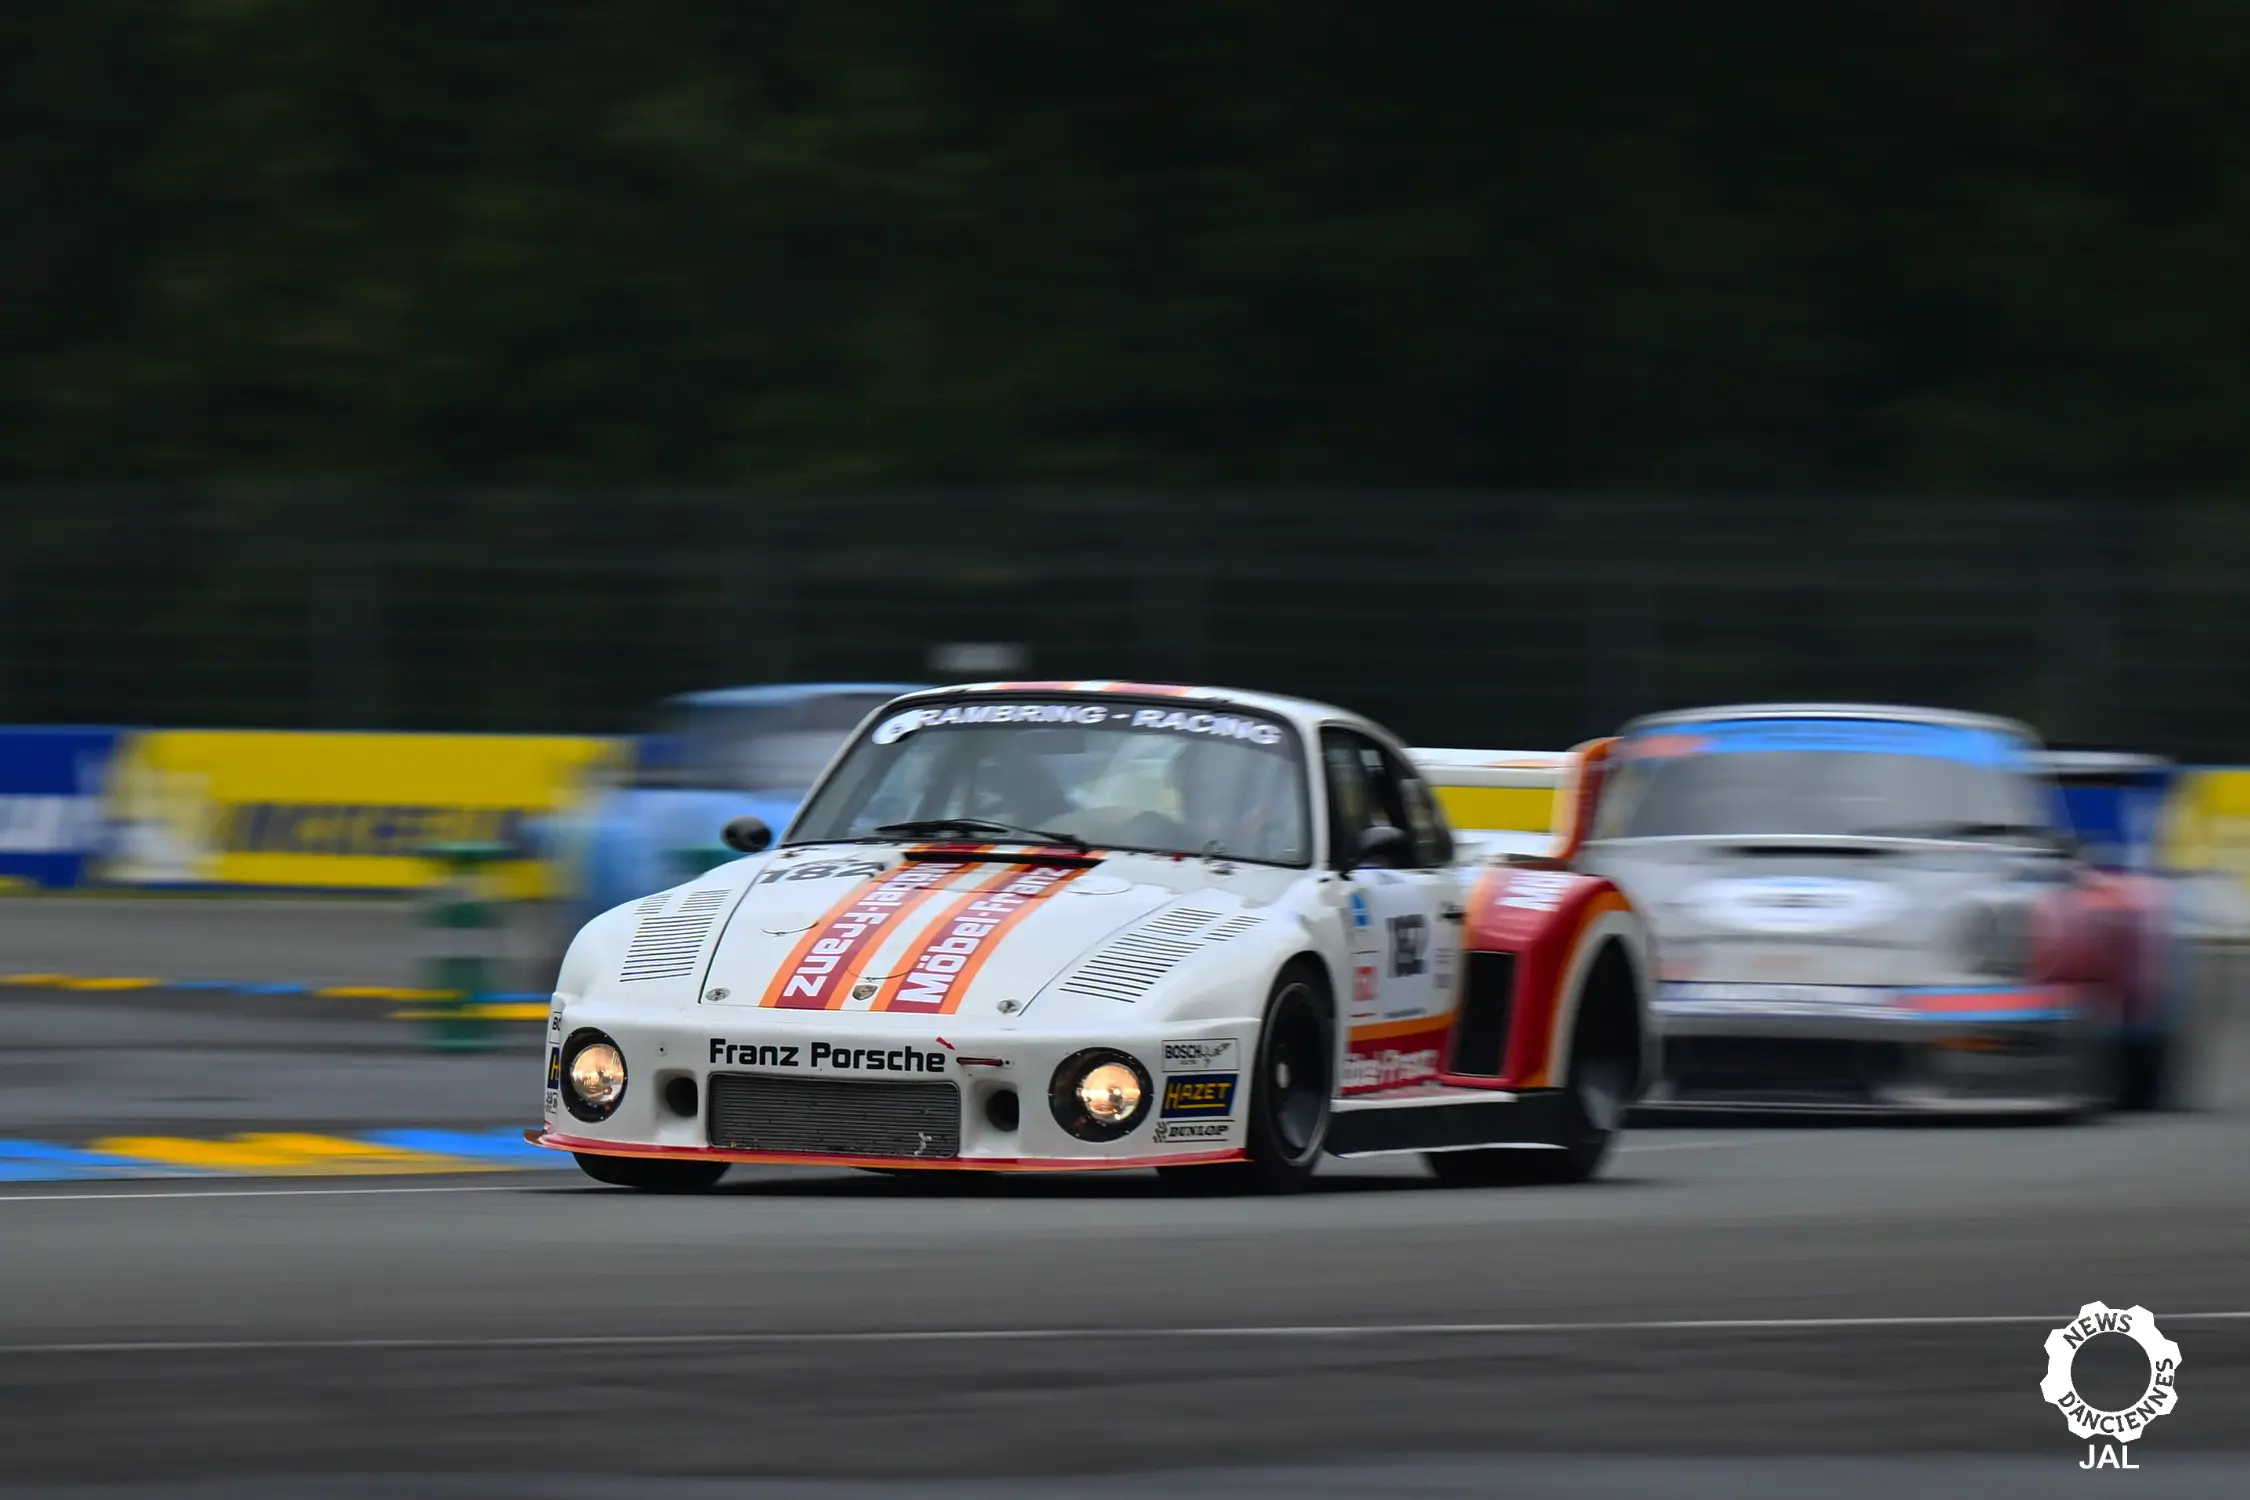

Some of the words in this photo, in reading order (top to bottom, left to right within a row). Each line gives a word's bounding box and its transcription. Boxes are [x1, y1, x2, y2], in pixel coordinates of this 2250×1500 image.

[917, 704, 1108, 726] RAMBRING
[1131, 709, 1282, 745] RACING
[758, 860, 885, 884] 182
[896, 867, 1075, 1004] Möbel-Franz
[709, 1038, 799, 1067] Franz
[811, 1042, 946, 1073] Porsche
[1164, 1044, 1201, 1060] BOSCH
[1164, 1082, 1232, 1109] HAZET
[1168, 1125, 1229, 1138] DUNLOP
